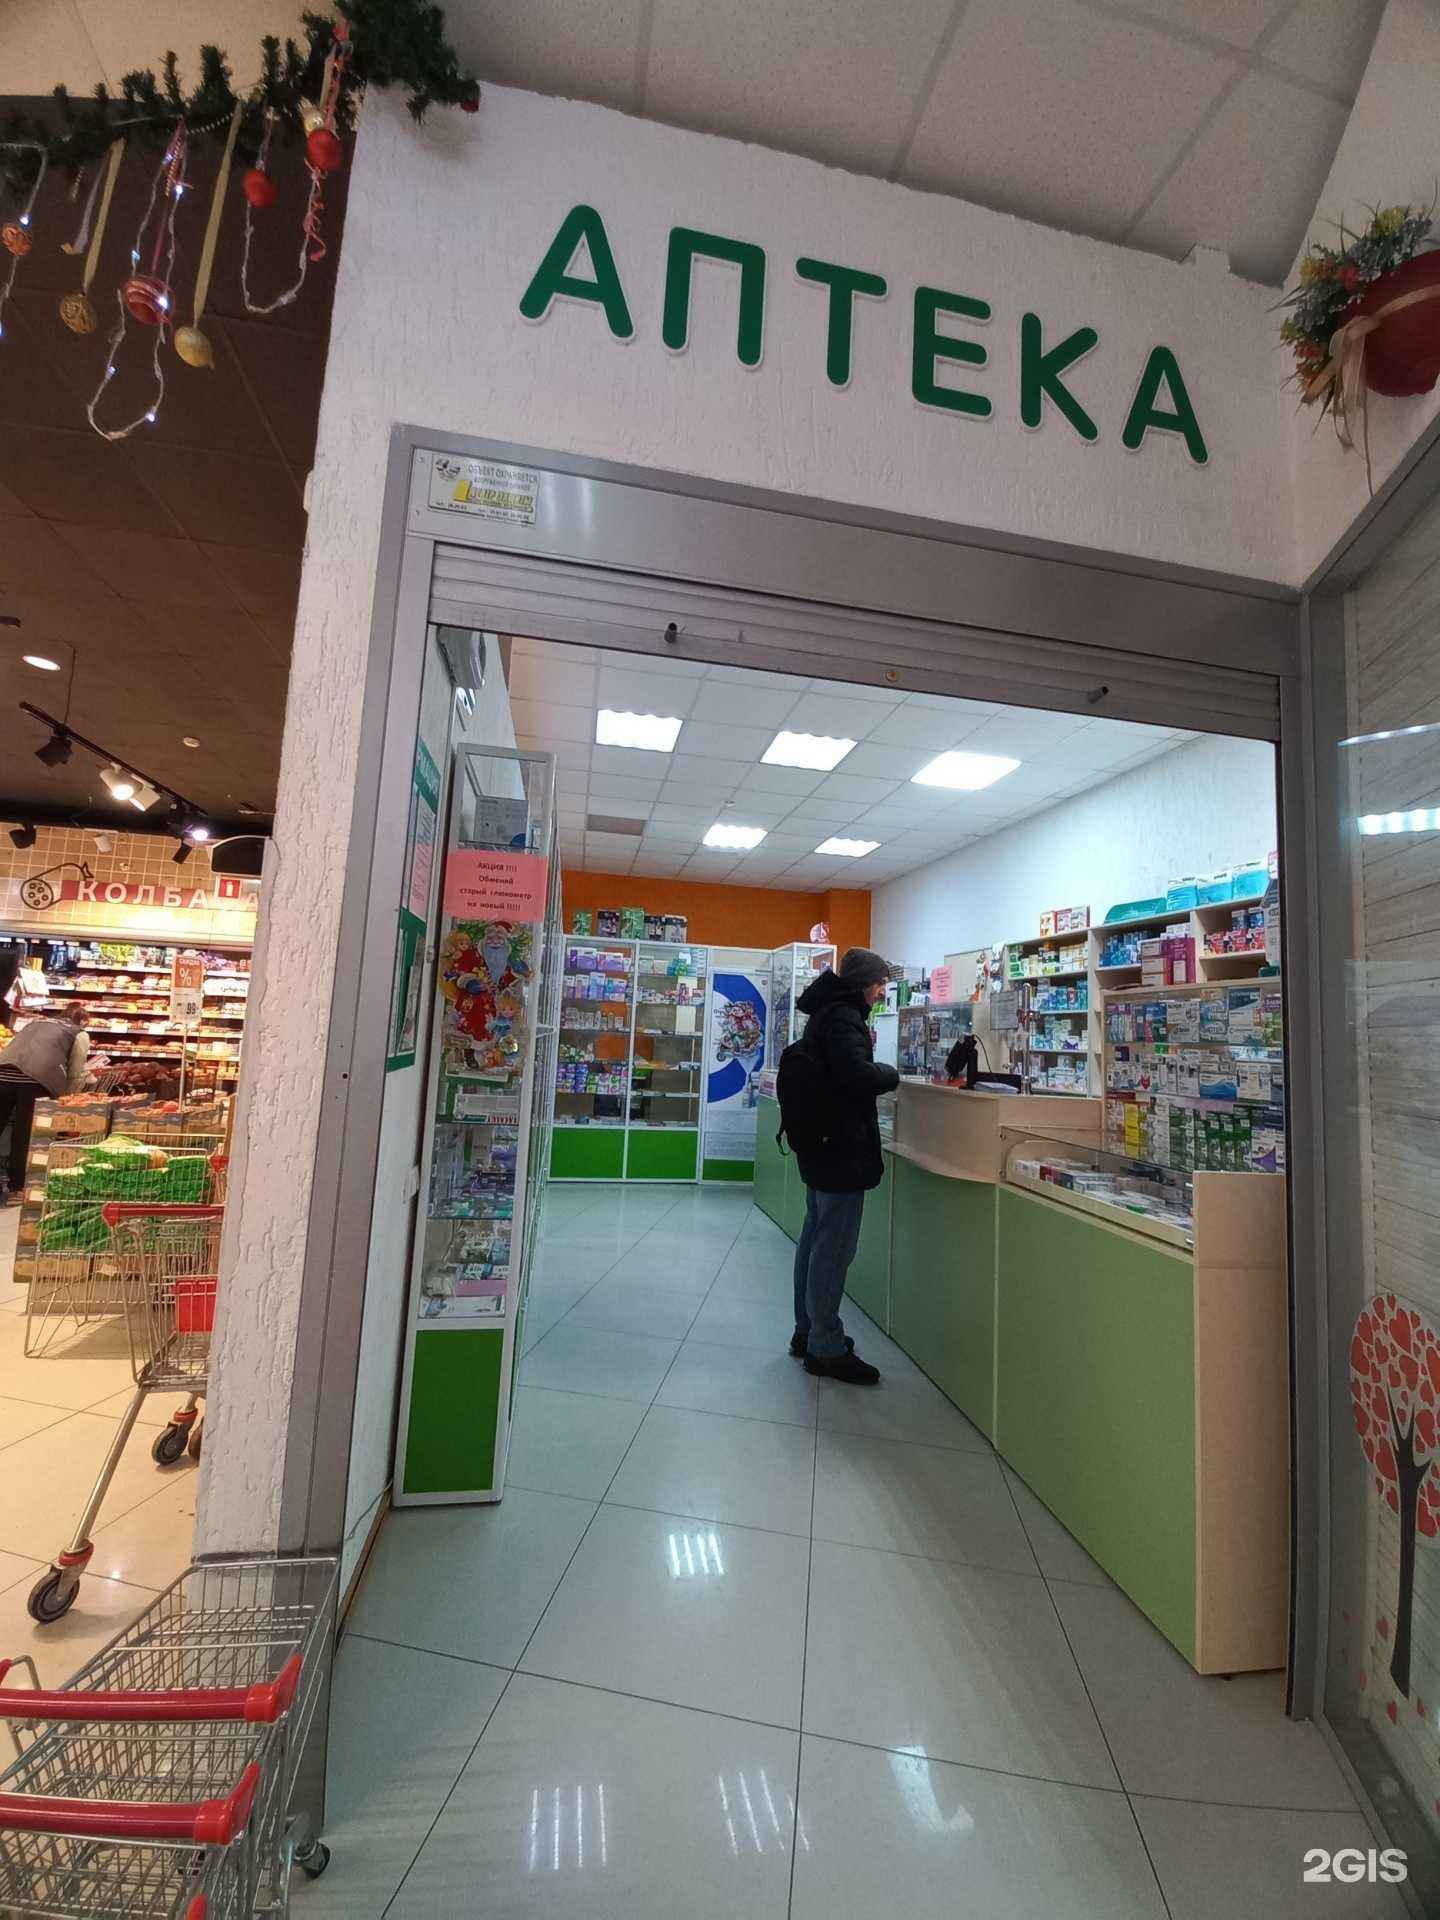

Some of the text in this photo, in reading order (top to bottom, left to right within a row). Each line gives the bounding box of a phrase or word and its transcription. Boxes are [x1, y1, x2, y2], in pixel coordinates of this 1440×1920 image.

[519, 203, 1210, 468] АПТЕКА
[78, 879, 257, 911] КОЛБАА
[459, 888, 532, 900] старый глюкометр
[480, 902, 504, 910] новый
